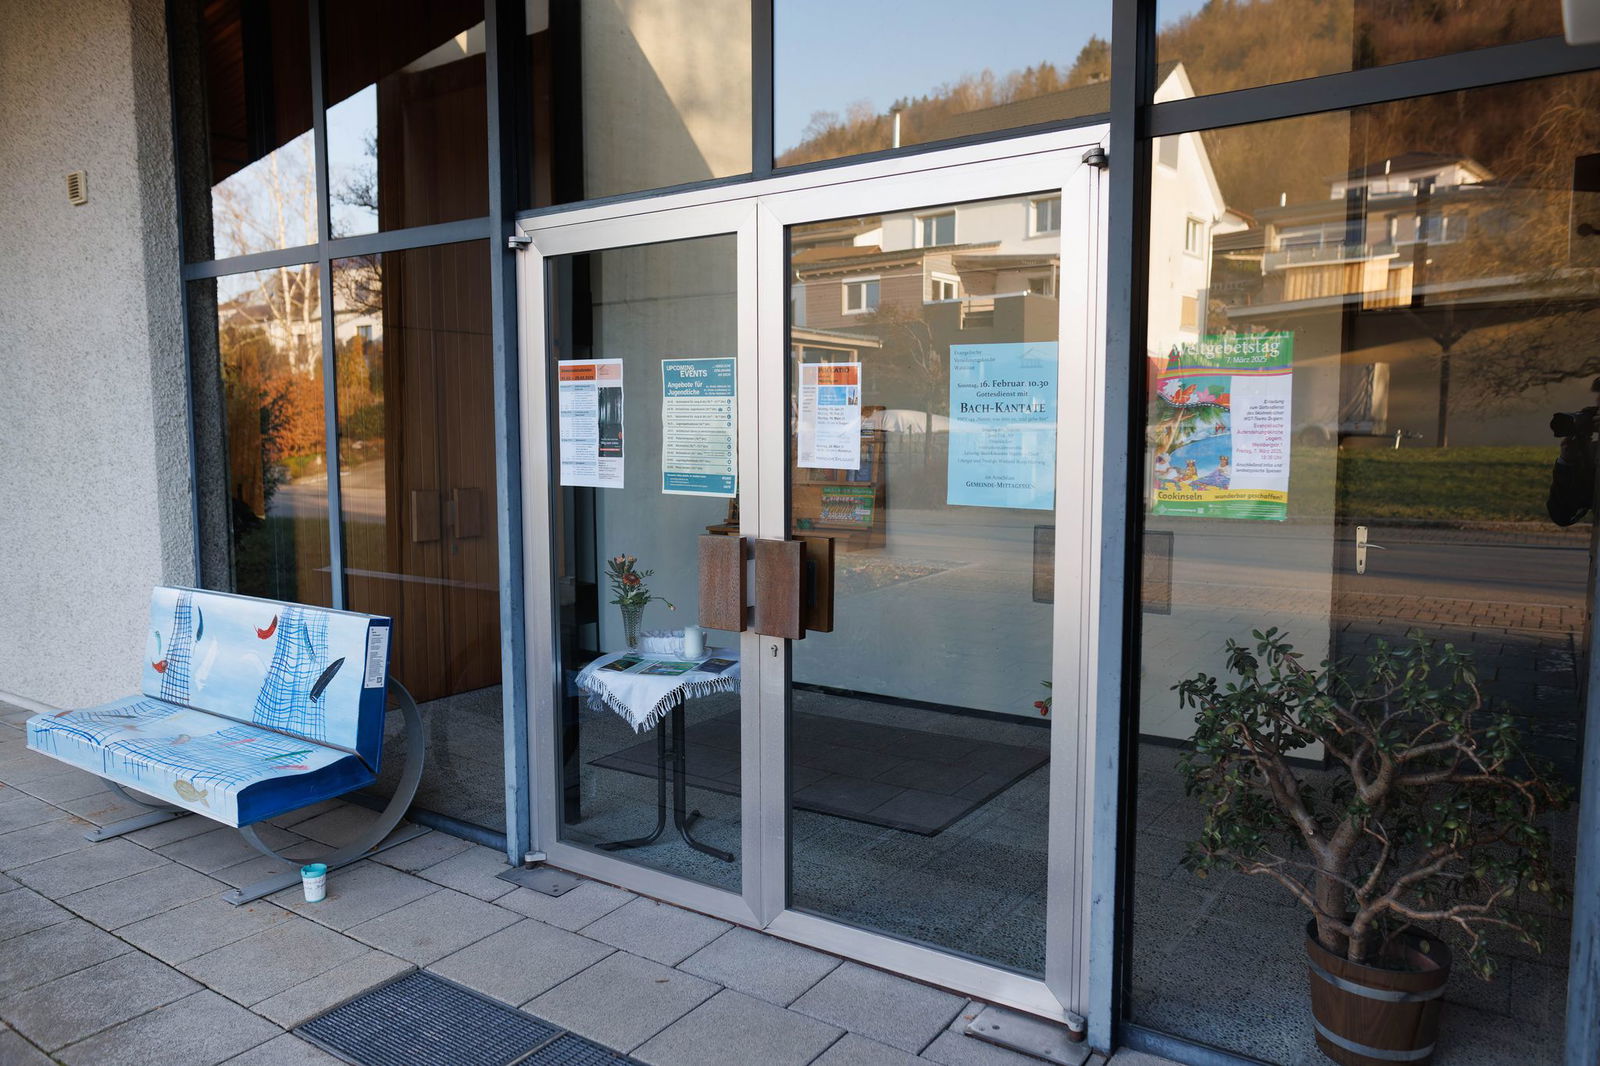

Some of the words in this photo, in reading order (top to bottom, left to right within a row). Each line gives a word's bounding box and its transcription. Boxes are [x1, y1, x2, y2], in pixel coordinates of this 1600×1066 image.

[680, 370, 707, 378] EVENTS
[668, 381, 694, 390] Angebote
[1028, 380, 1049, 389] 10.30
[668, 389, 700, 397] Jugendliche
[1158, 491, 1203, 501] Cookinseln
